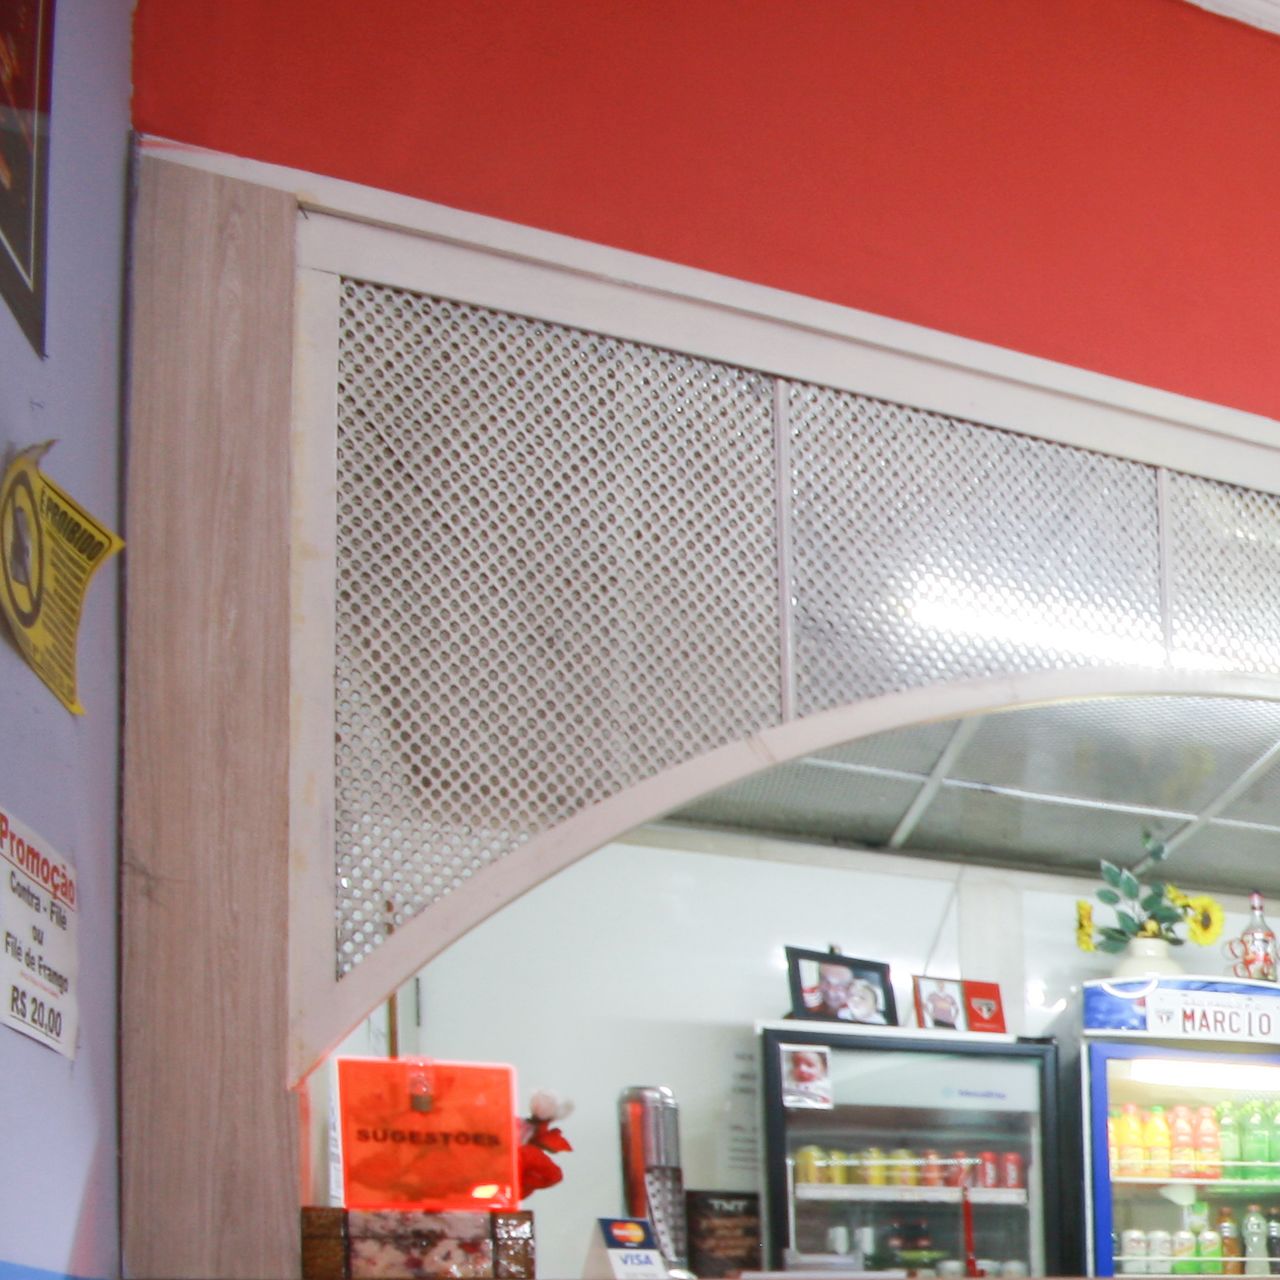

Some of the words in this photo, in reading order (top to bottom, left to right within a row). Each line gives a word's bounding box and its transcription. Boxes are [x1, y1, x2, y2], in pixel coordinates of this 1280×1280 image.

[45, 497, 105, 562] PROIBIDO
[0, 812, 76, 904] Promoção
[10, 870, 41, 914] Contra
[50, 901, 68, 931] Filé
[32, 925, 44, 946] ou
[5, 931, 23, 962] Filé
[25, 948, 36, 972] de
[38, 957, 69, 995] Frango
[31, 996, 63, 1038] 20,00
[1181, 1008, 1271, 1037] MARCIO
[709, 1200, 748, 1212] TNT
[620, 1253, 654, 1265] VISA
